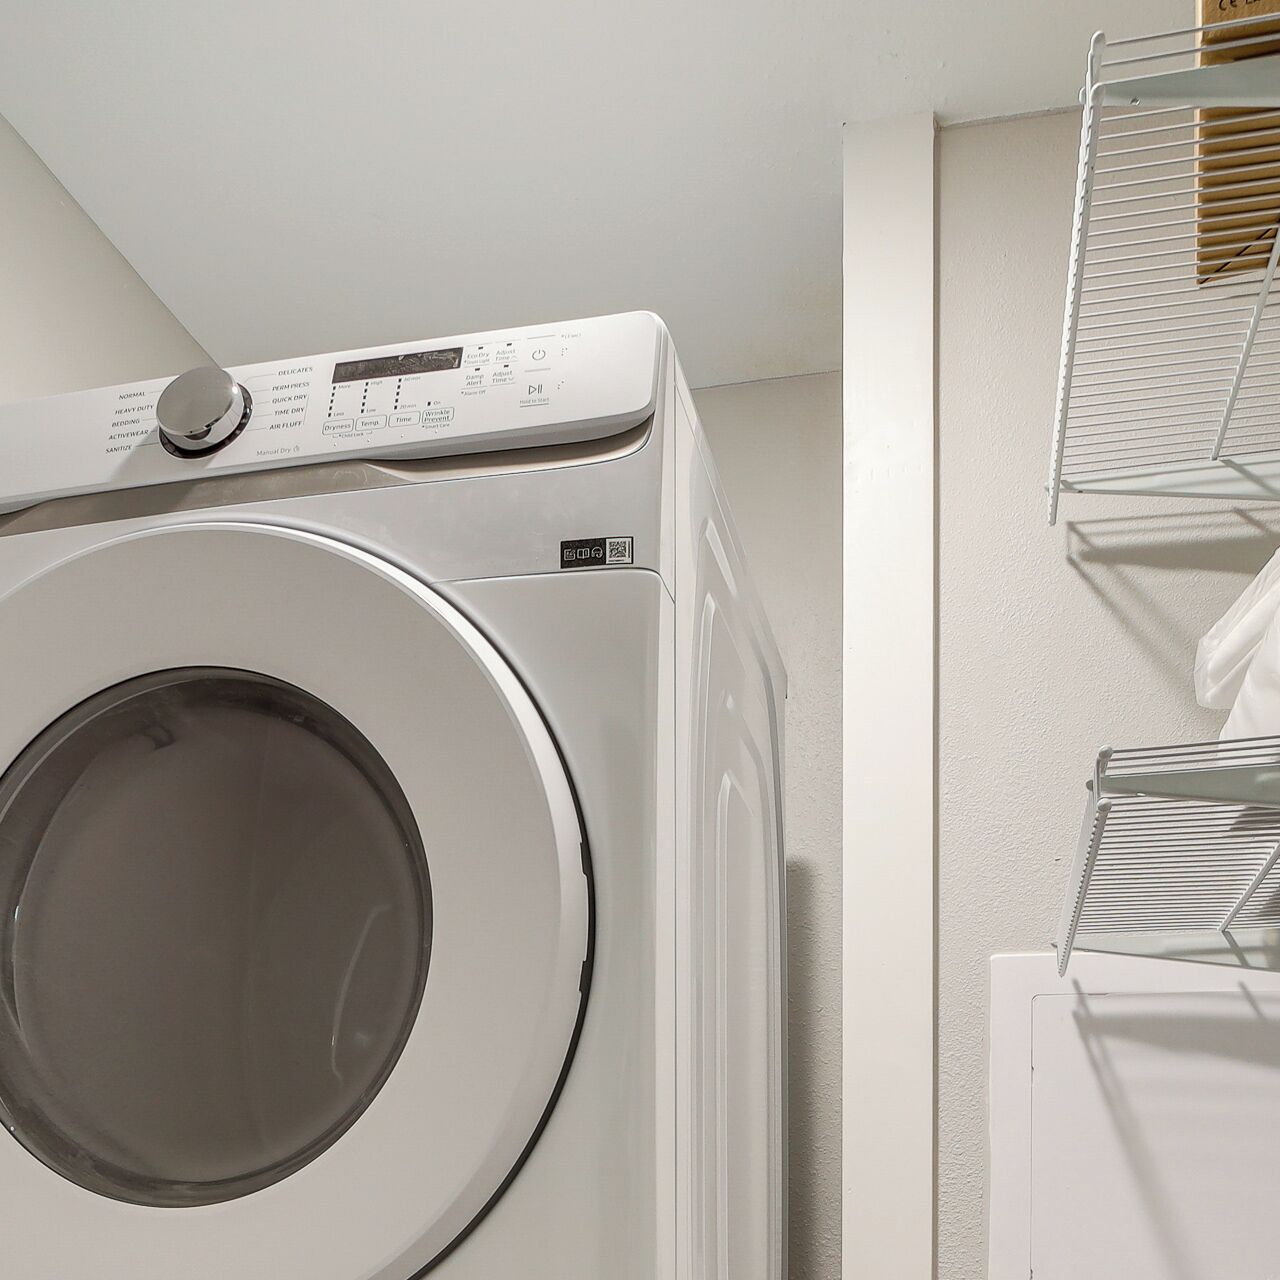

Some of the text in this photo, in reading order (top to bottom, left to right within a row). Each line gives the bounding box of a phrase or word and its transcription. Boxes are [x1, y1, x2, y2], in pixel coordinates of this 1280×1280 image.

[278, 367, 313, 376] DELICATES
[272, 384, 290, 392] PERM
[119, 392, 145, 400] NORMAL
[272, 396, 292, 404] QUICK
[115, 407, 136, 415] HEAVY
[274, 409, 289, 417] TIME
[425, 409, 450, 417] Wrinkle
[112, 418, 140, 427] BEDDING
[424, 415, 449, 423] Prevent
[269, 420, 302, 431] AIR FLUFF
[324, 423, 351, 431] Dryness
[109, 430, 148, 440] ACTIVEWEAR
[106, 445, 132, 453] SANITIZE
[256, 448, 279, 456] Manual
